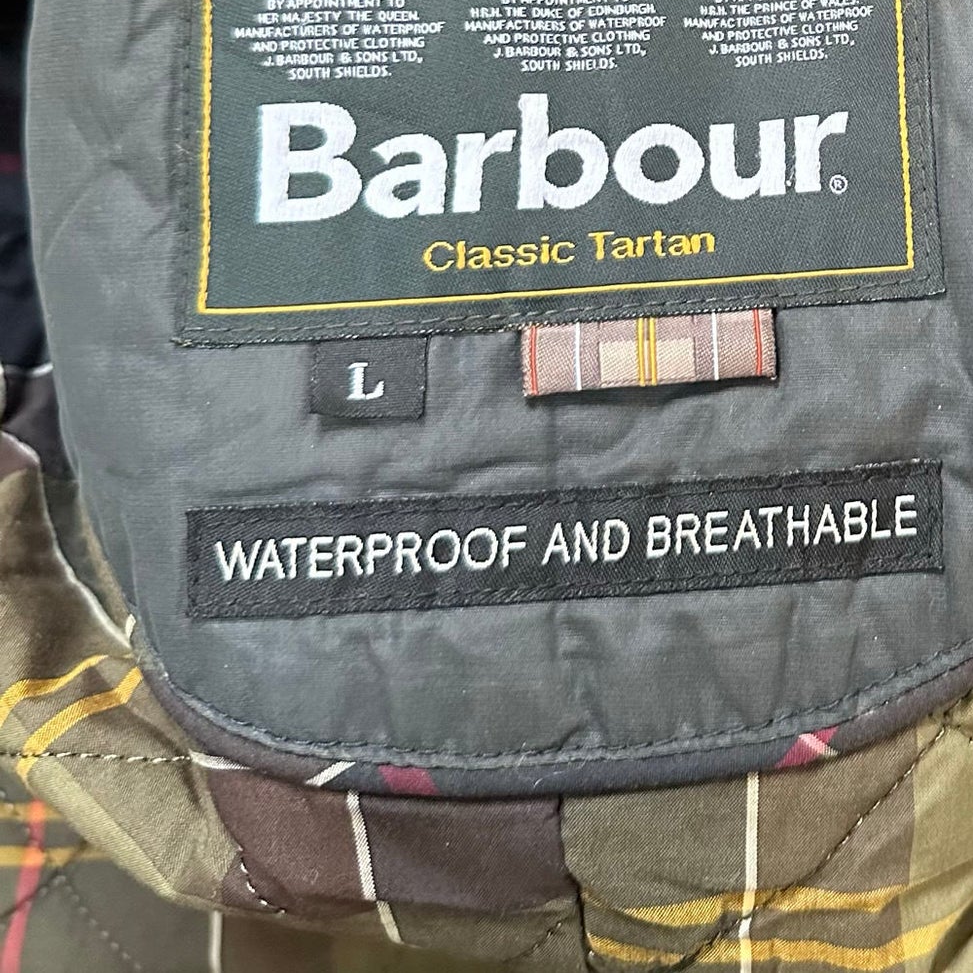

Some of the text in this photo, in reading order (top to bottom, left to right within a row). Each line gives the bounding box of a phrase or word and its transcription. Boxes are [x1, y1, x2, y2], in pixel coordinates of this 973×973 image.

[504, 6, 527, 18] THE
[531, 7, 563, 19] DUKE
[567, 6, 584, 18] OF
[730, 3, 751, 15] THE
[753, 0, 798, 14] PRINCE
[257, 12, 279, 25] HER
[282, 11, 342, 24] MAJESTY
[348, 10, 373, 22] THE
[464, 16, 667, 32] MANUFACTURERS OF WATERPROOF
[683, 5, 875, 29] MANUFACTURERS OF WATERPROOF
[234, 21, 446, 39] MANUFACTURERS OF WATERPROOF
[483, 29, 651, 46] AND PROTECTIVE CLOTHING
[701, 20, 859, 42] AND PROTECTIVE CLOTHING
[252, 36, 426, 53] AND PROTECTIVE CLOTHING
[505, 46, 562, 58] BARBOUR
[565, 46, 579, 58] &
[580, 44, 613, 58] SONS
[720, 41, 773, 55] BARBOUR
[777, 38, 789, 50] &
[791, 35, 822, 50] SONS
[276, 53, 335, 66] BARBOUR
[340, 52, 352, 64] &
[354, 51, 389, 63] SONS
[521, 59, 561, 72] SOUTH
[735, 53, 773, 68] SOUTH
[289, 66, 331, 80] SOUTH
[422, 230, 716, 272] Classic Tartan
[346, 362, 385, 400] L
[214, 494, 918, 581] WATERPROOF AND BREATHABLE
